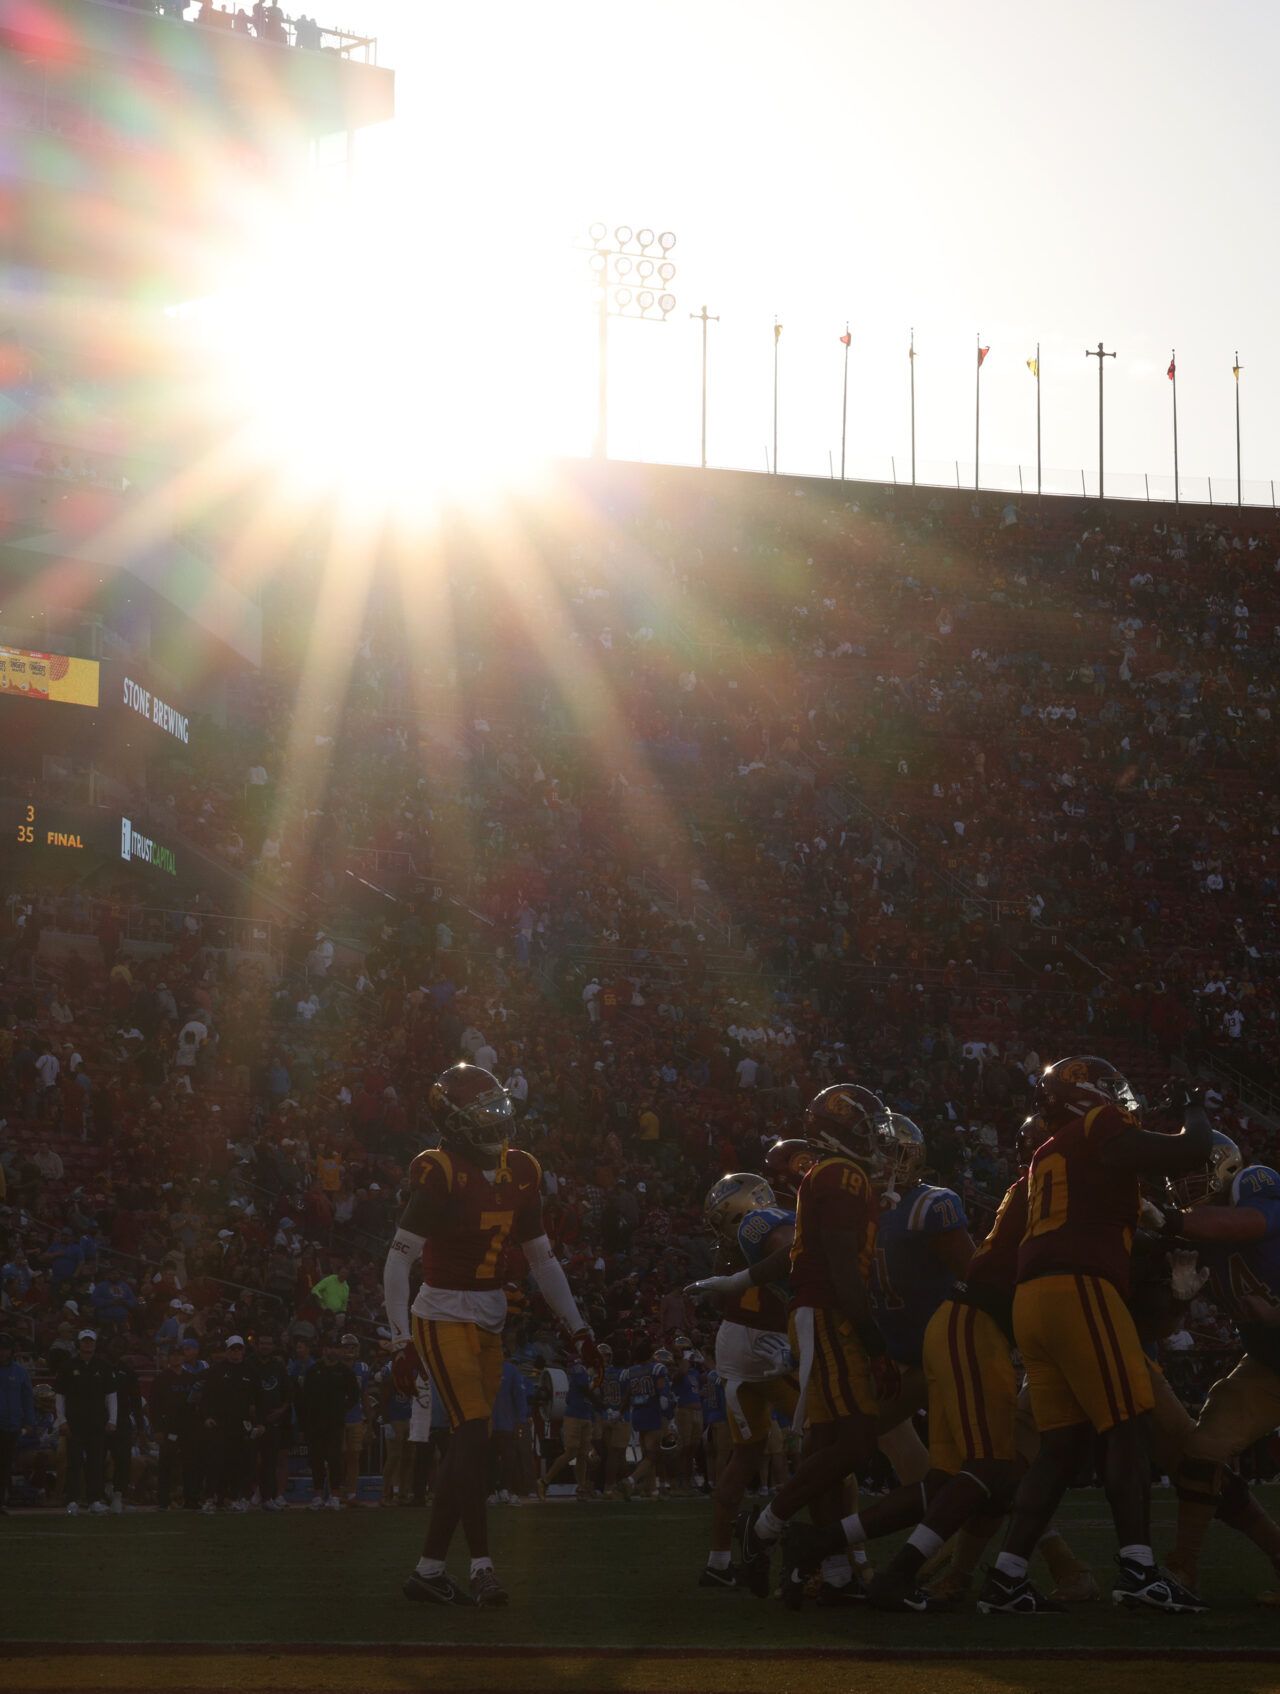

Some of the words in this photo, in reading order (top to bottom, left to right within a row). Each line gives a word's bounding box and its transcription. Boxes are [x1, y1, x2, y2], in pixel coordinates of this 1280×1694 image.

[123, 677, 151, 719] STONE
[153, 696, 189, 744] BREWING
[26, 805, 35, 822] 3
[17, 825, 34, 843] 35
[47, 831, 84, 849] FINAL
[415, 1160, 434, 1185] 7
[840, 1167, 864, 1197] 19
[1240, 1168, 1276, 1193] 74
[932, 1199, 960, 1228] 71
[742, 1215, 770, 1244] 88
[475, 1210, 515, 1280] 7
